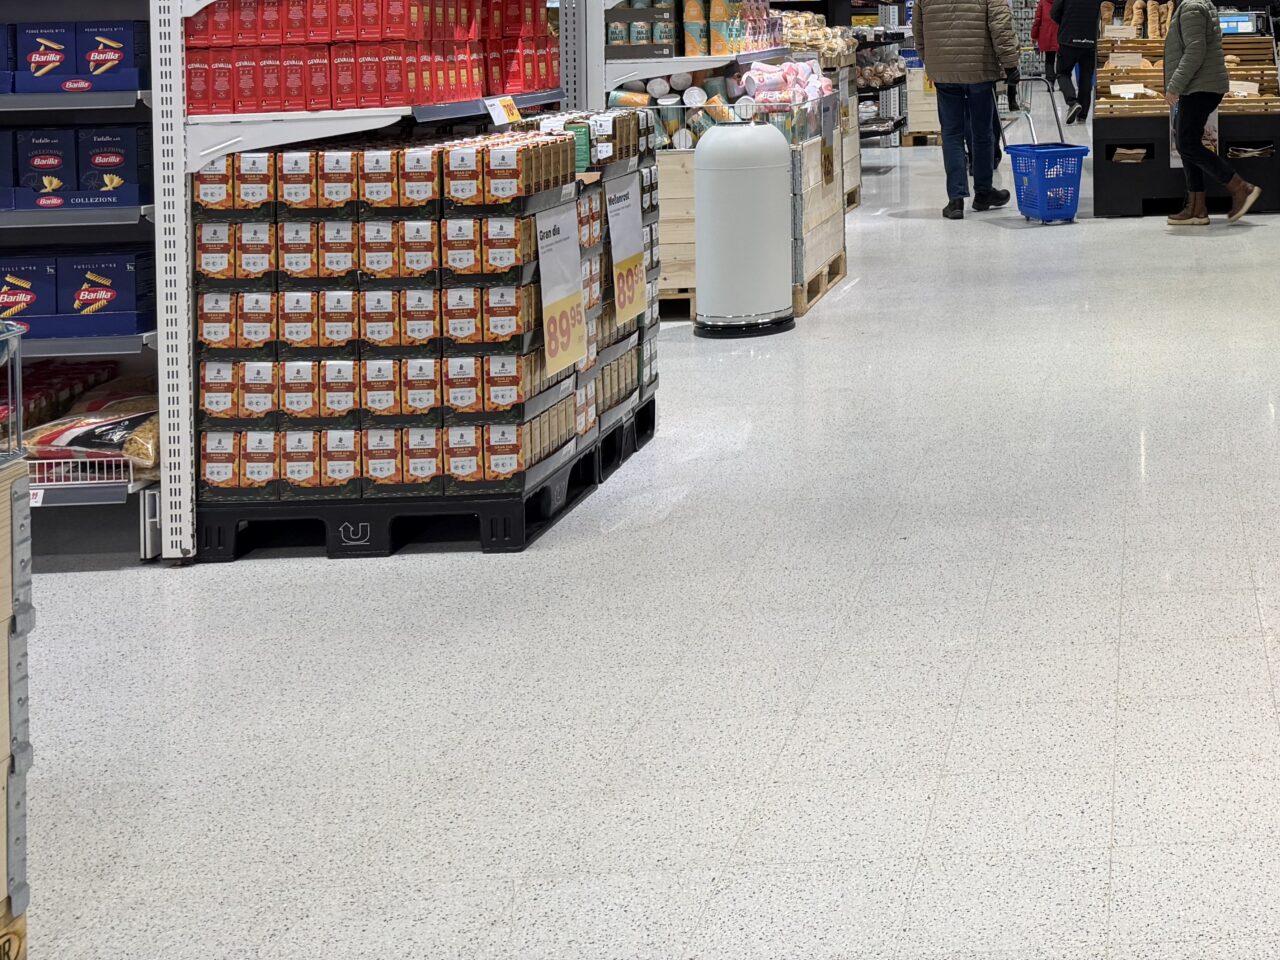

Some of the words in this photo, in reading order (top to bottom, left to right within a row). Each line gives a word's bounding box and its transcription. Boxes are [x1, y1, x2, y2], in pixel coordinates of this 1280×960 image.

[31, 54, 61, 62] Barilla
[90, 52, 120, 60] Barilla
[94, 156, 121, 164] Barilla
[70, 196, 118, 204] COLLEZIONE
[608, 192, 630, 207] Mellanrost
[539, 229, 552, 241] Gran
[0, 294, 32, 302] Barilla
[80, 291, 113, 300] Barilla
